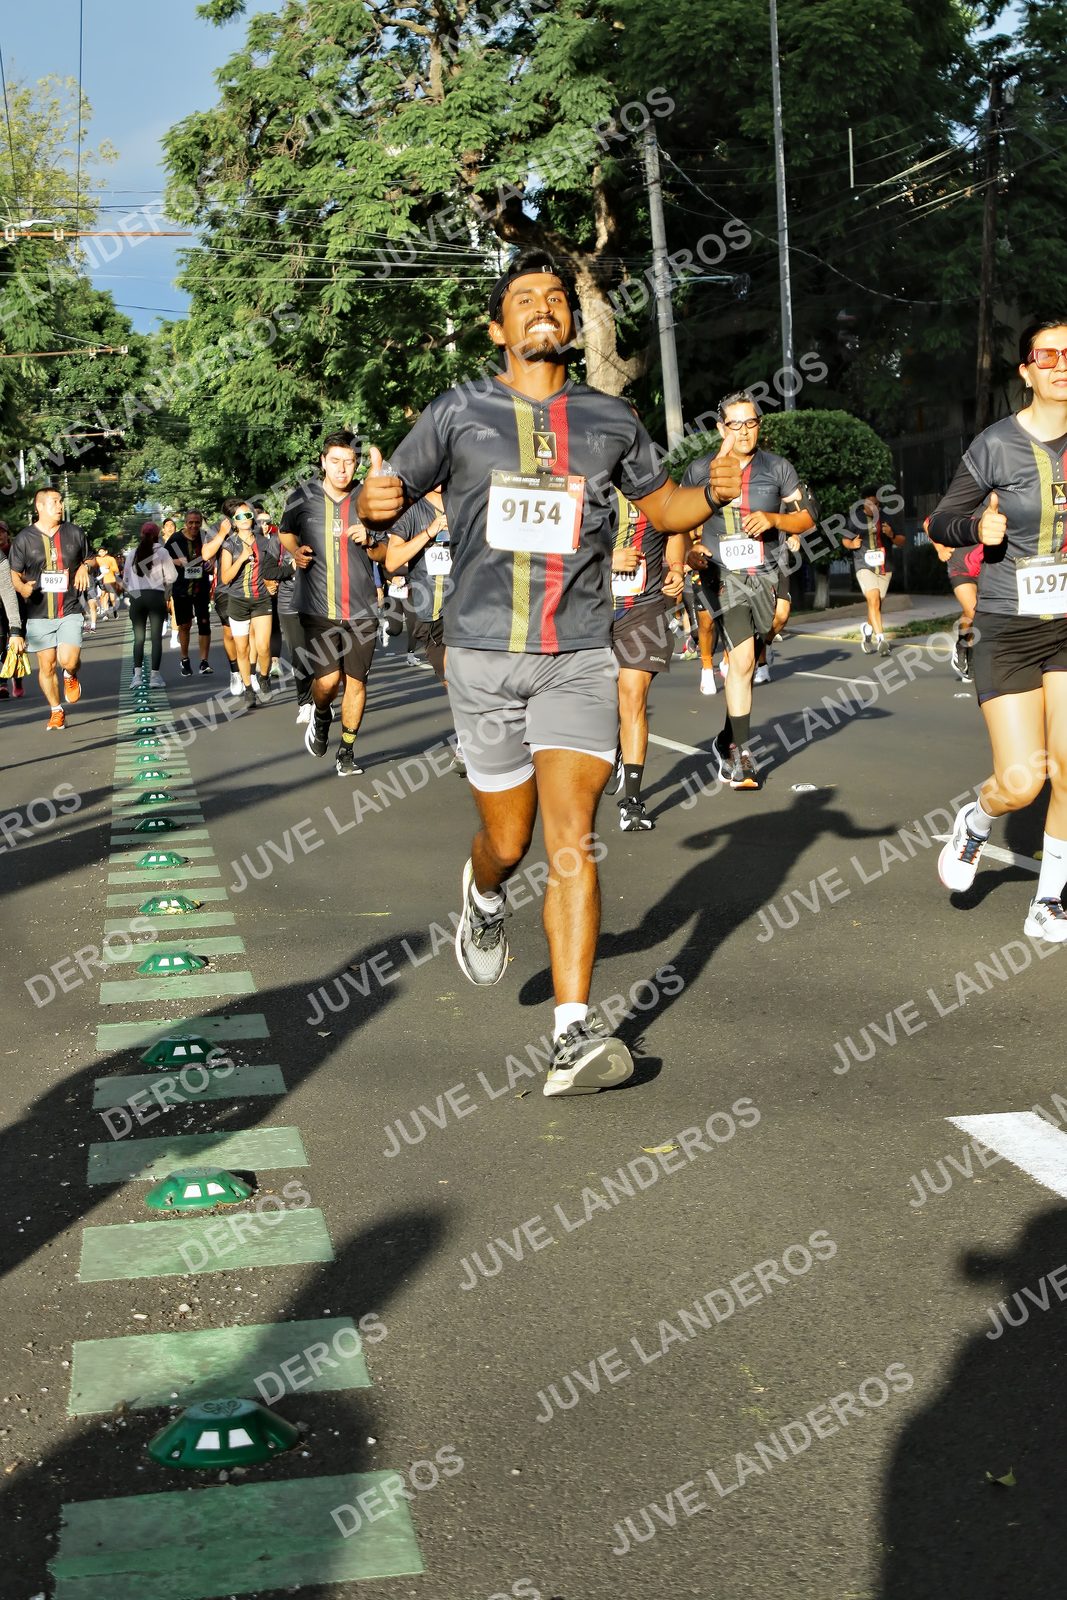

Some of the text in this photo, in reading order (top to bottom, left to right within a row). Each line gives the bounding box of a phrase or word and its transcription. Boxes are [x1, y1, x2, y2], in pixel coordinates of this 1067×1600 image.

[501, 497, 562, 525] 9154
[725, 543, 754, 558] 8028
[44, 576, 63, 584] 9897
[1022, 572, 1067, 595] 1297
